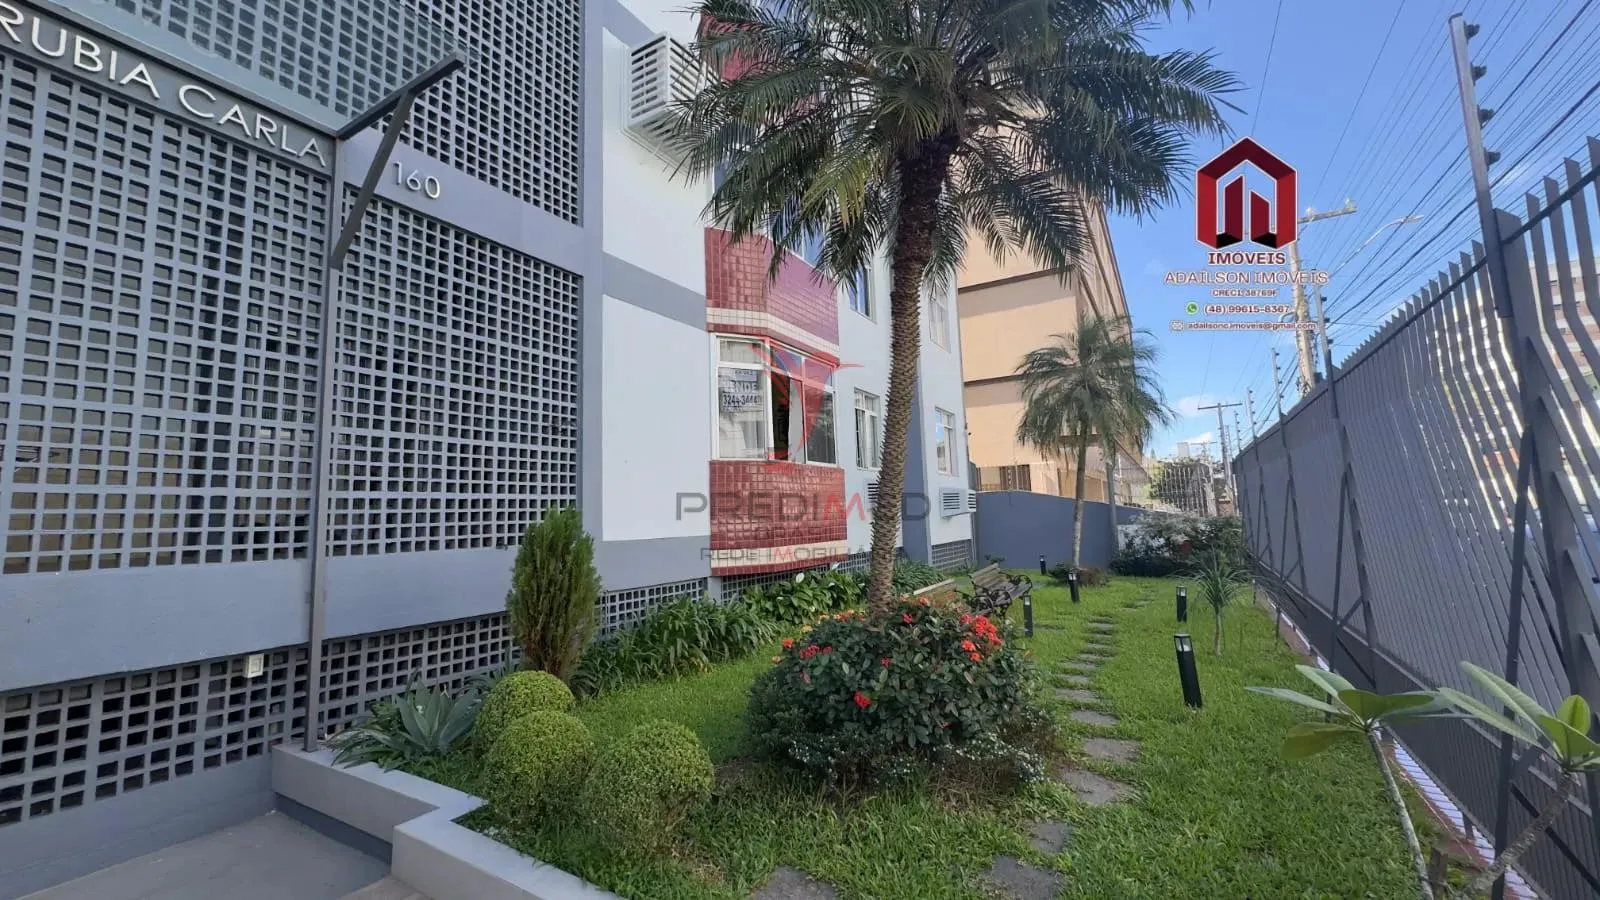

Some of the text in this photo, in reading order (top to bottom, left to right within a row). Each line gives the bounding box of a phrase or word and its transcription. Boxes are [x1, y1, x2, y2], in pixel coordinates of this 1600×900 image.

[0, 1, 326, 168] RUBIA CARLA
[393, 161, 440, 199] 160
